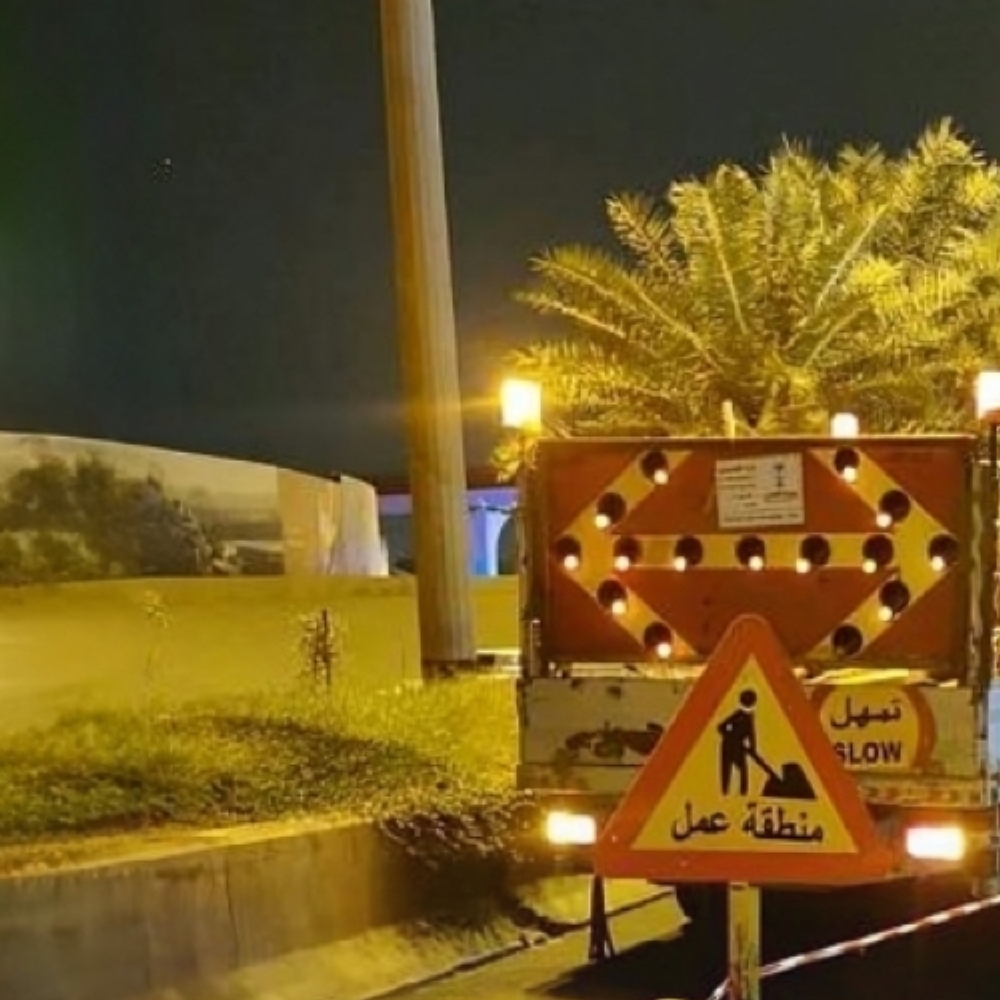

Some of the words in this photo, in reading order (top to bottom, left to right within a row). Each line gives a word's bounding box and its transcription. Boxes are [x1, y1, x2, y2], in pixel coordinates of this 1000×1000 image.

[830, 696, 902, 729] تمهل
[833, 742, 902, 764] SLOW
[671, 802, 729, 840] عمل
[742, 803, 824, 842] منطقة
